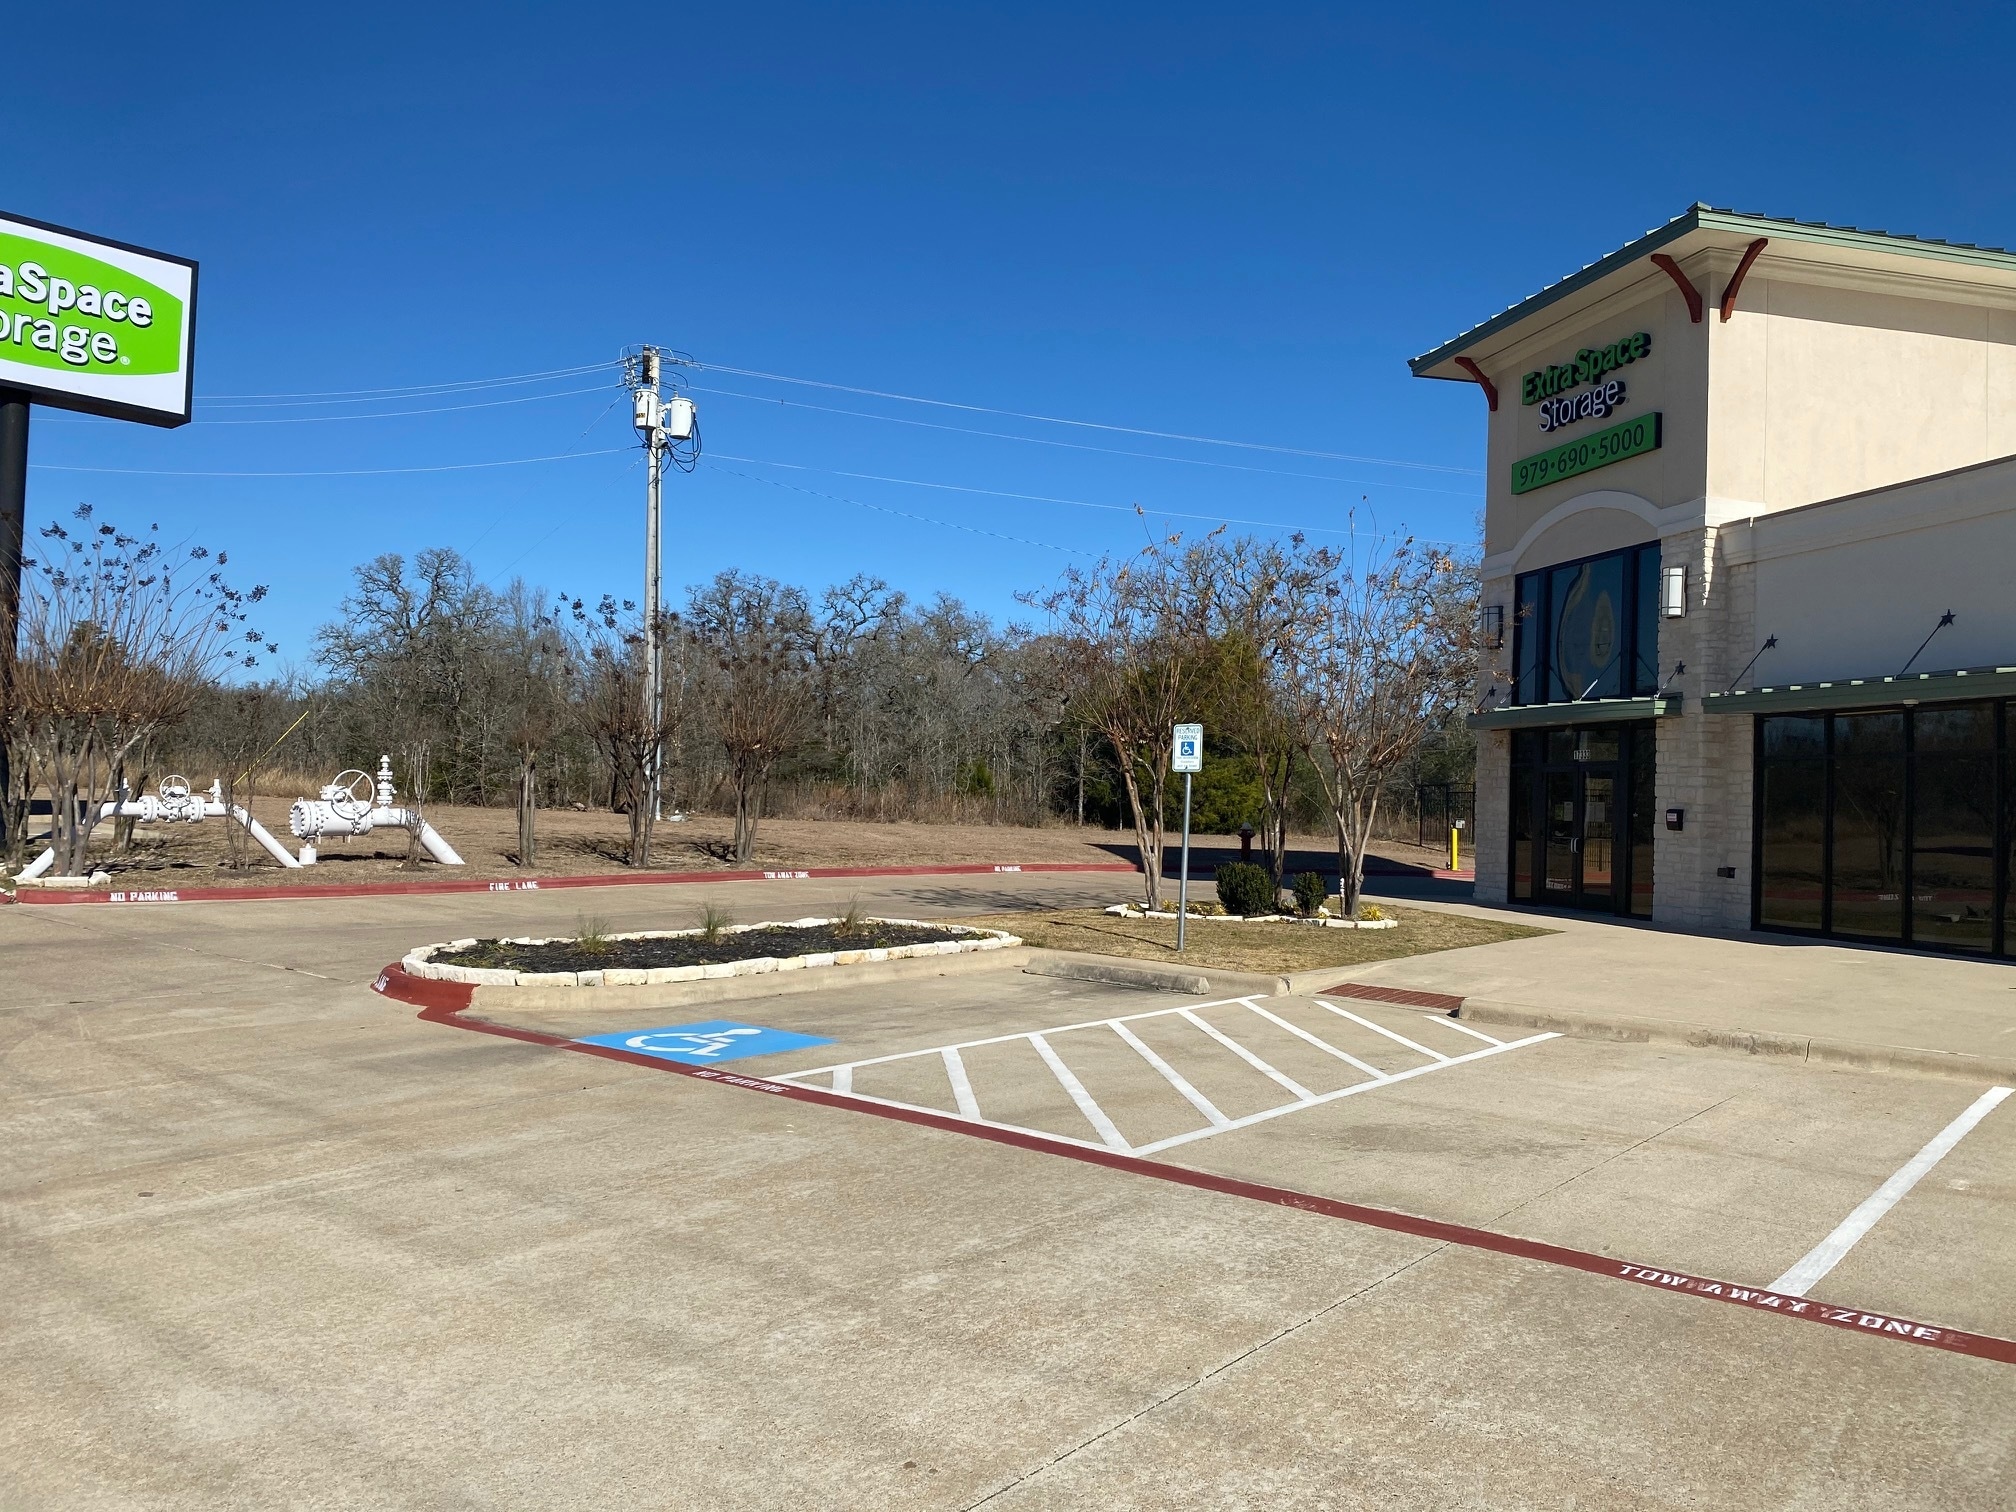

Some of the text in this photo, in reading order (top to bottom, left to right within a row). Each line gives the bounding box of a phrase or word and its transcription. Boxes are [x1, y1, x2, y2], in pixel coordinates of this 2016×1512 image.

[17, 261, 153, 328] Space
[1522, 332, 1651, 405] Extra Space
[1538, 380, 1624, 432] Storage
[110, 891, 178, 902] NO PARKING
[489, 880, 539, 891] FIRE LANE
[716, 1075, 790, 1093] PARKING
[1619, 1264, 1942, 1341] TOW AWAY ZONE
